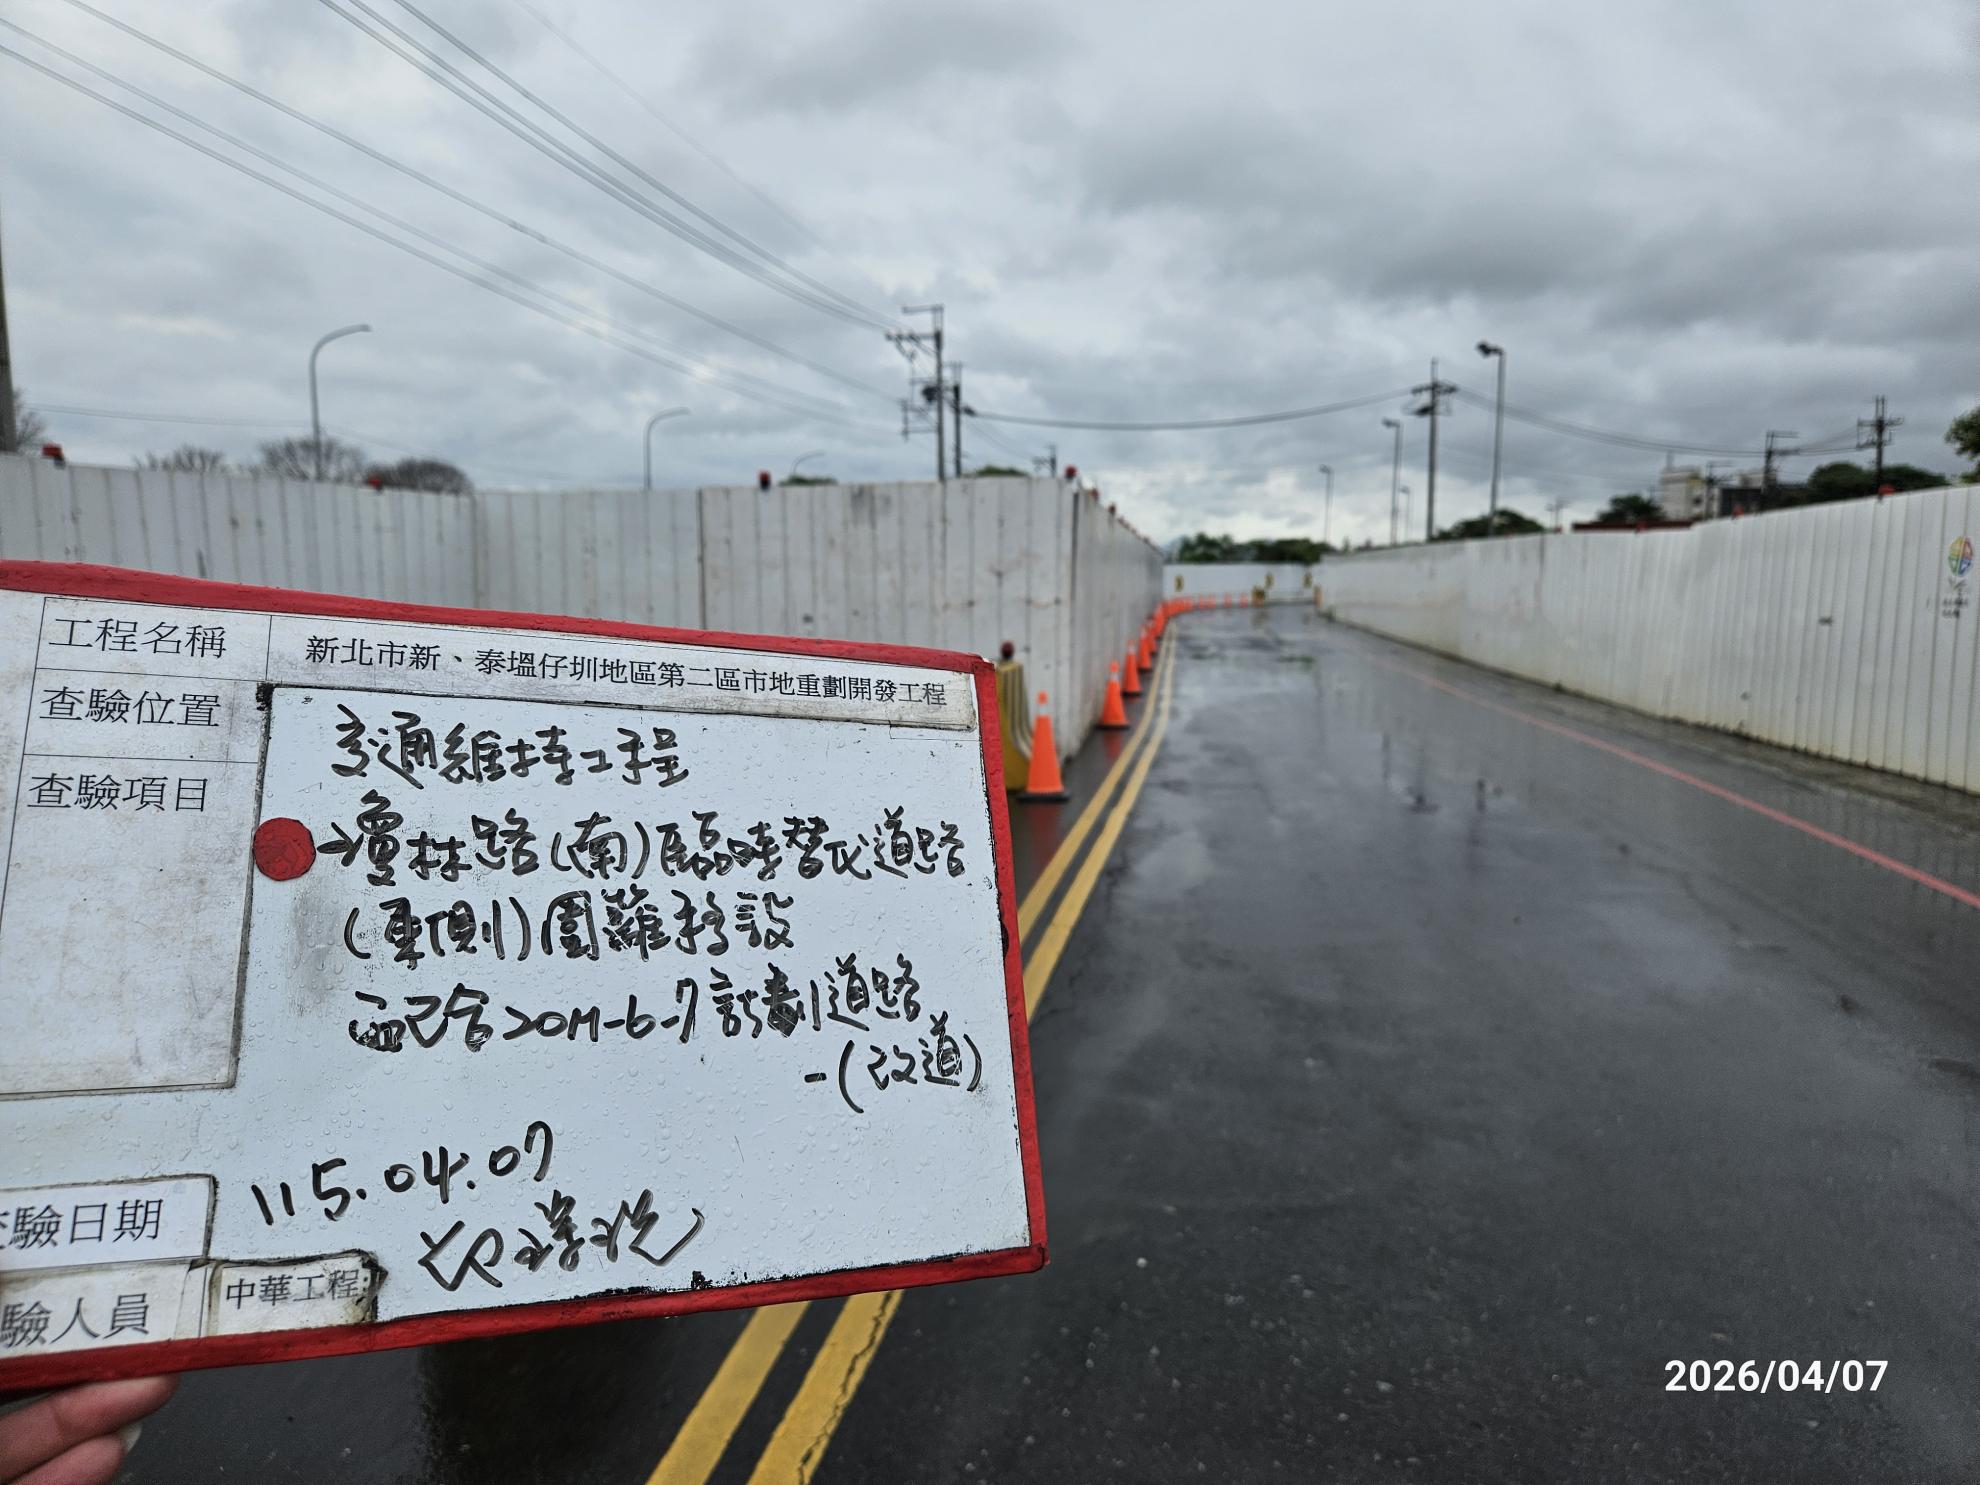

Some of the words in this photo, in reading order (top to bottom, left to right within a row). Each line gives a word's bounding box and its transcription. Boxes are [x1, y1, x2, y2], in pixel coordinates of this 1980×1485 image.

[48, 617, 227, 660] 工程名稱
[305, 635, 948, 707] 新北市新、泰塭仔圳地區第二區市地重劃開發工程
[39, 686, 222, 728] 查驗位置
[27, 773, 209, 813] 查驗項目
[251, 1120, 554, 1225] 115.04.07
[226, 1269, 360, 1309] 中華工程
